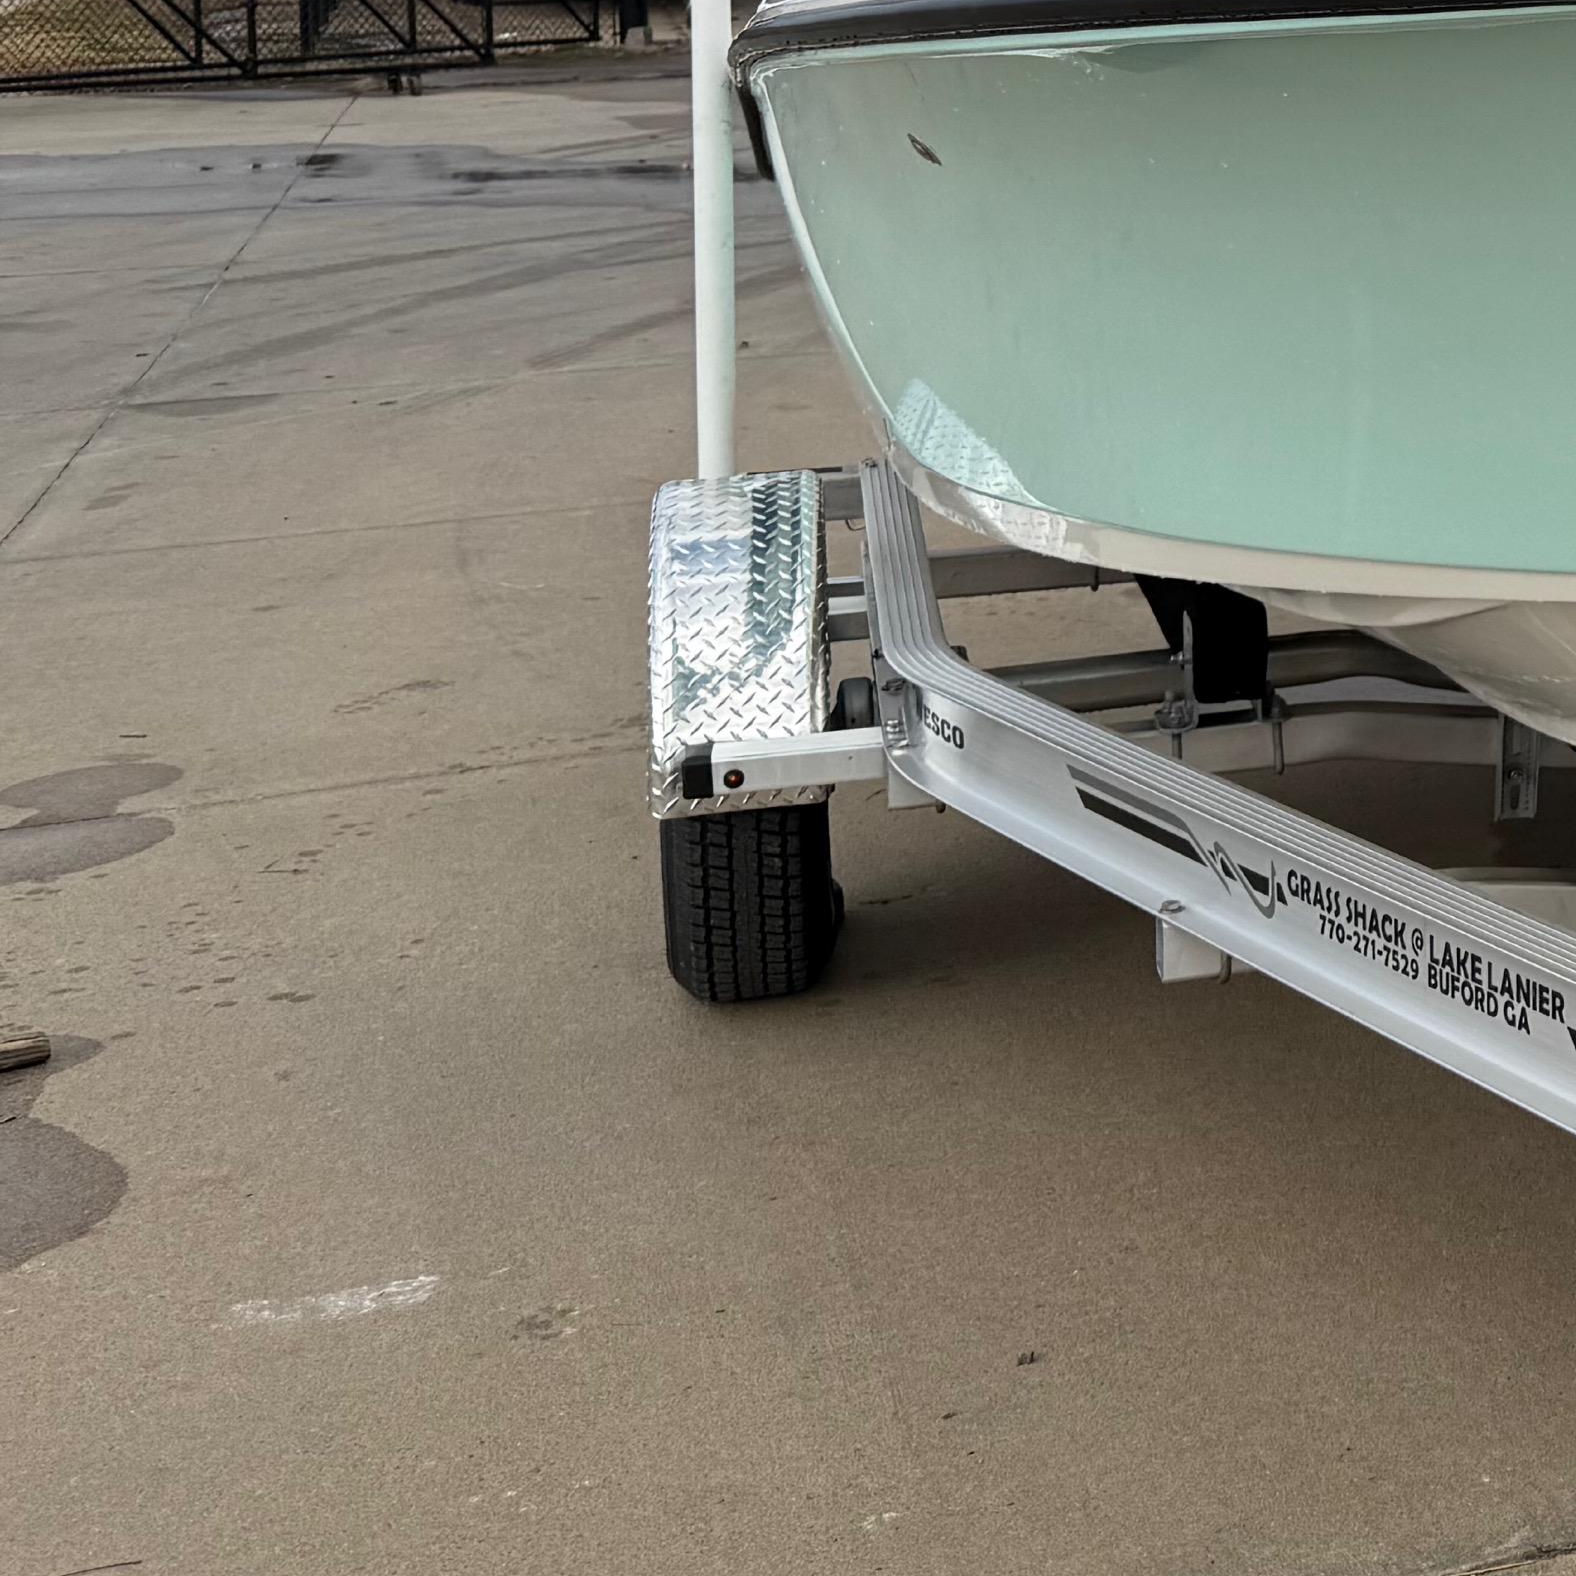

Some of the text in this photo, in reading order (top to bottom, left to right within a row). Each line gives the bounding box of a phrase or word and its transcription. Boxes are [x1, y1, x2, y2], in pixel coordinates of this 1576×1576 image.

[920, 703, 965, 749] ESCO
[1287, 868, 1565, 1024] GRASS SHACK @ LAKE LANIER
[1319, 913, 1531, 1036] 770-271-7529 BUFORD GA
